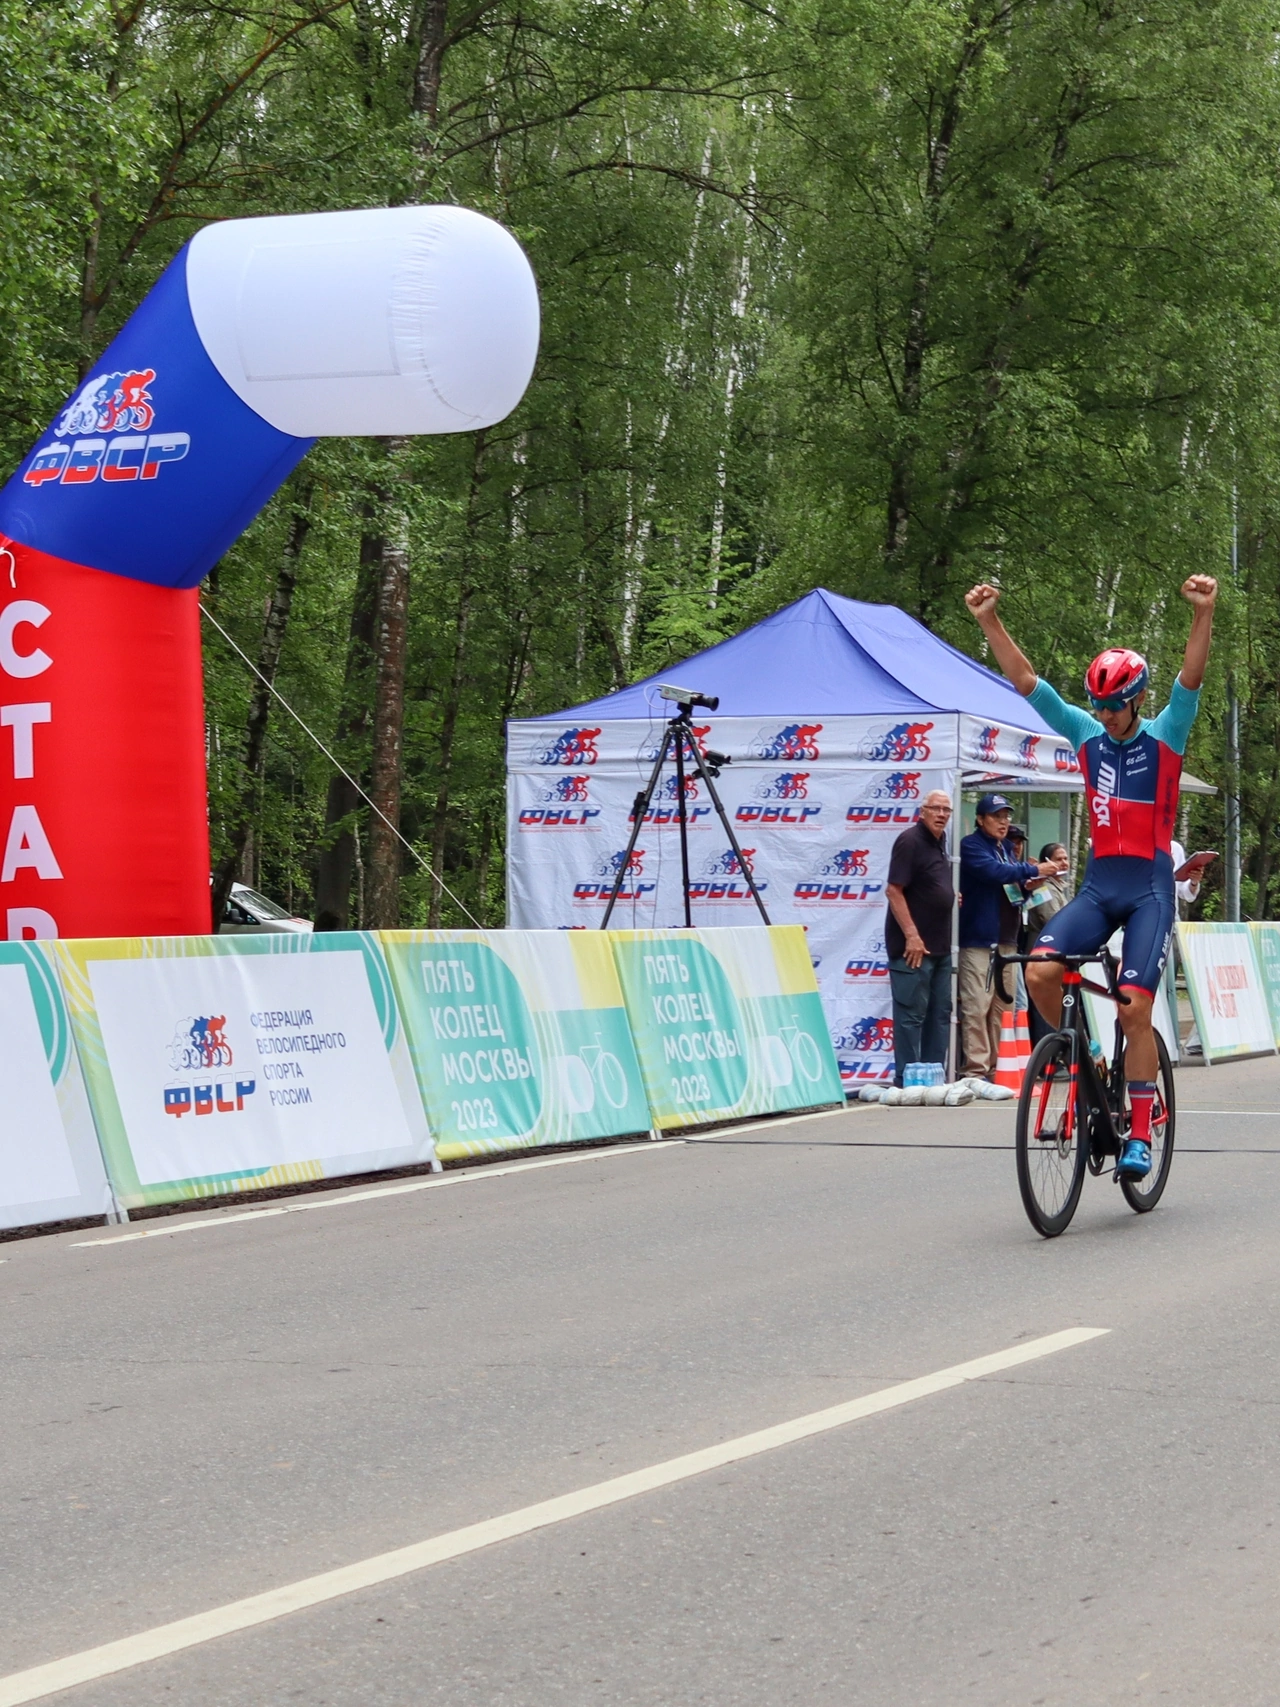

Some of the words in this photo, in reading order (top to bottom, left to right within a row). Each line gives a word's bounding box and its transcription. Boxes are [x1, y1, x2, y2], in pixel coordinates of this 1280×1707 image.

[23, 432, 191, 487] ФВСР
[518, 804, 602, 825] ФВСР
[735, 802, 822, 823] ФВСР
[572, 878, 658, 899] ФВСР
[794, 879, 884, 899] ФВСР
[420, 960, 475, 993] ПЯТЬ
[643, 954, 690, 984] ПЯТЬ
[250, 1009, 314, 1031] ФЕДЕРАЦИЯ
[429, 1004, 506, 1043] КОЛЕЦ
[652, 992, 716, 1026] КОЛЕЦ
[256, 1032, 347, 1055] ВЕЛОСИПЕДНОГО
[663, 1029, 742, 1064] МОСКВЫ
[263, 1062, 304, 1080] СПОРТА
[441, 1046, 536, 1085] МОСКВЫ
[163, 1070, 256, 1118] ФВСР
[269, 1087, 313, 1106] РОССИИ
[671, 1074, 711, 1104] 2023
[451, 1098, 498, 1131] 2023
